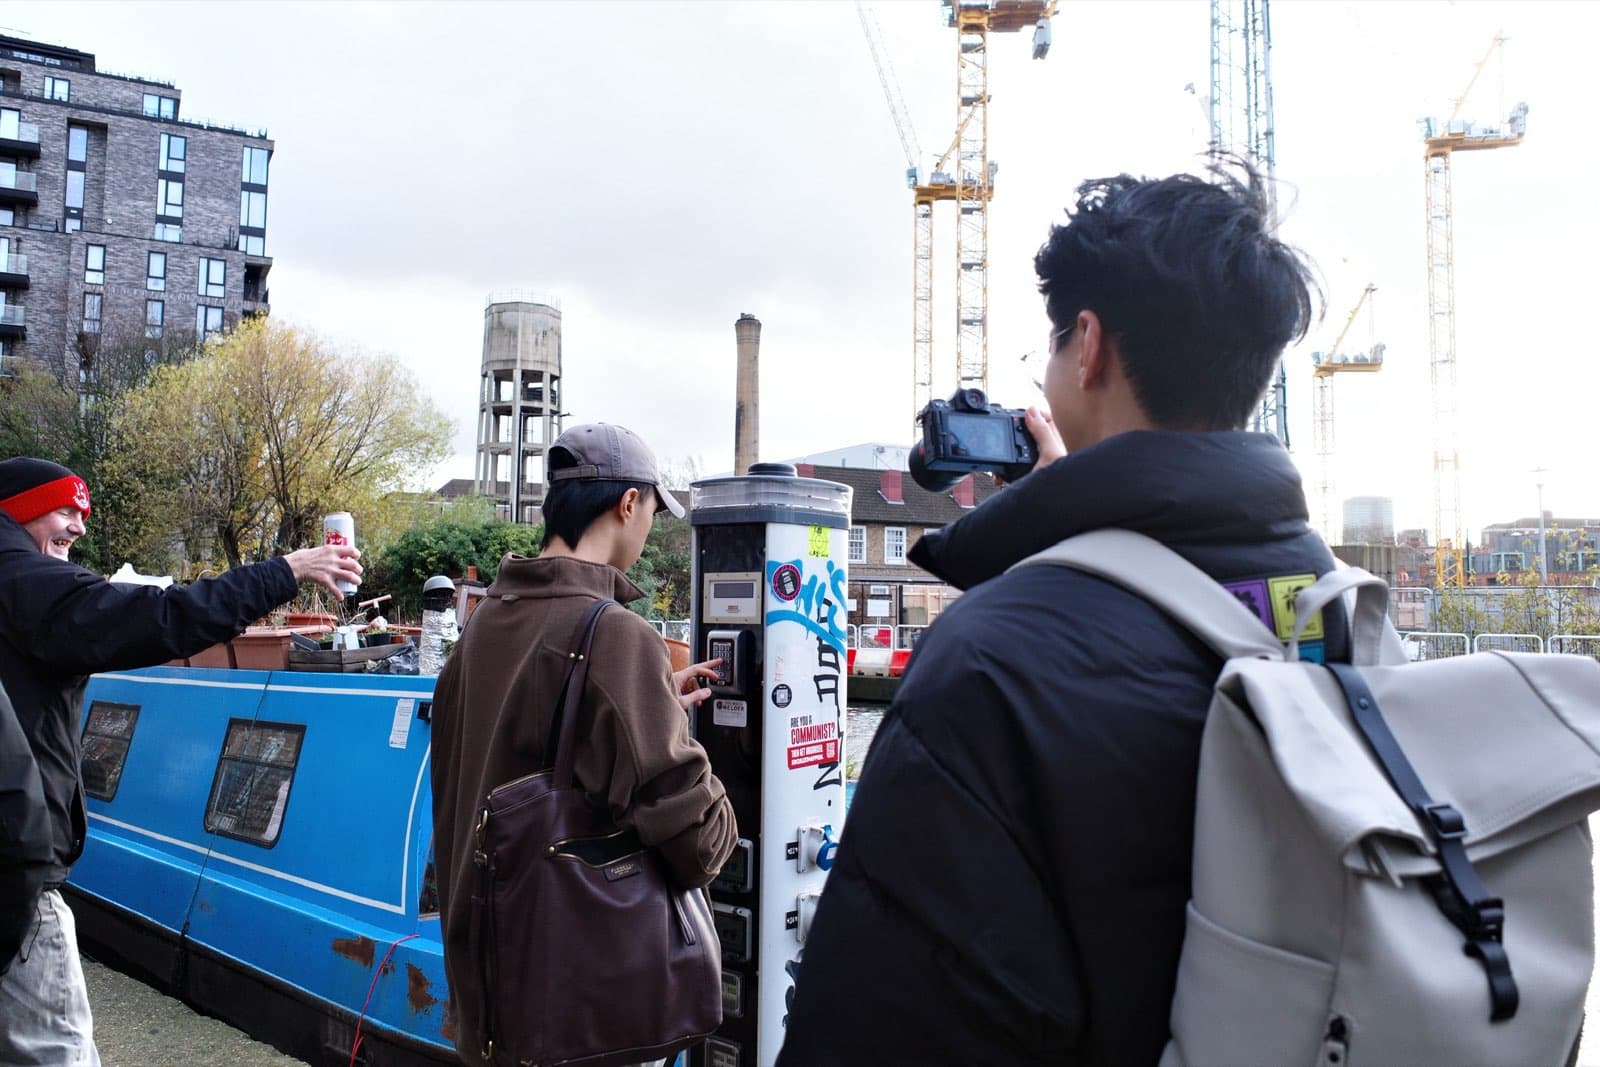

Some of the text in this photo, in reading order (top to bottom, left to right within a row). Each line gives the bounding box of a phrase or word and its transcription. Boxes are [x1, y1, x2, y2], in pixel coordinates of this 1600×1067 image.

[790, 717, 799, 728] ARE
[800, 715, 808, 726] YOU
[791, 722, 835, 745] COMMUNIST?
